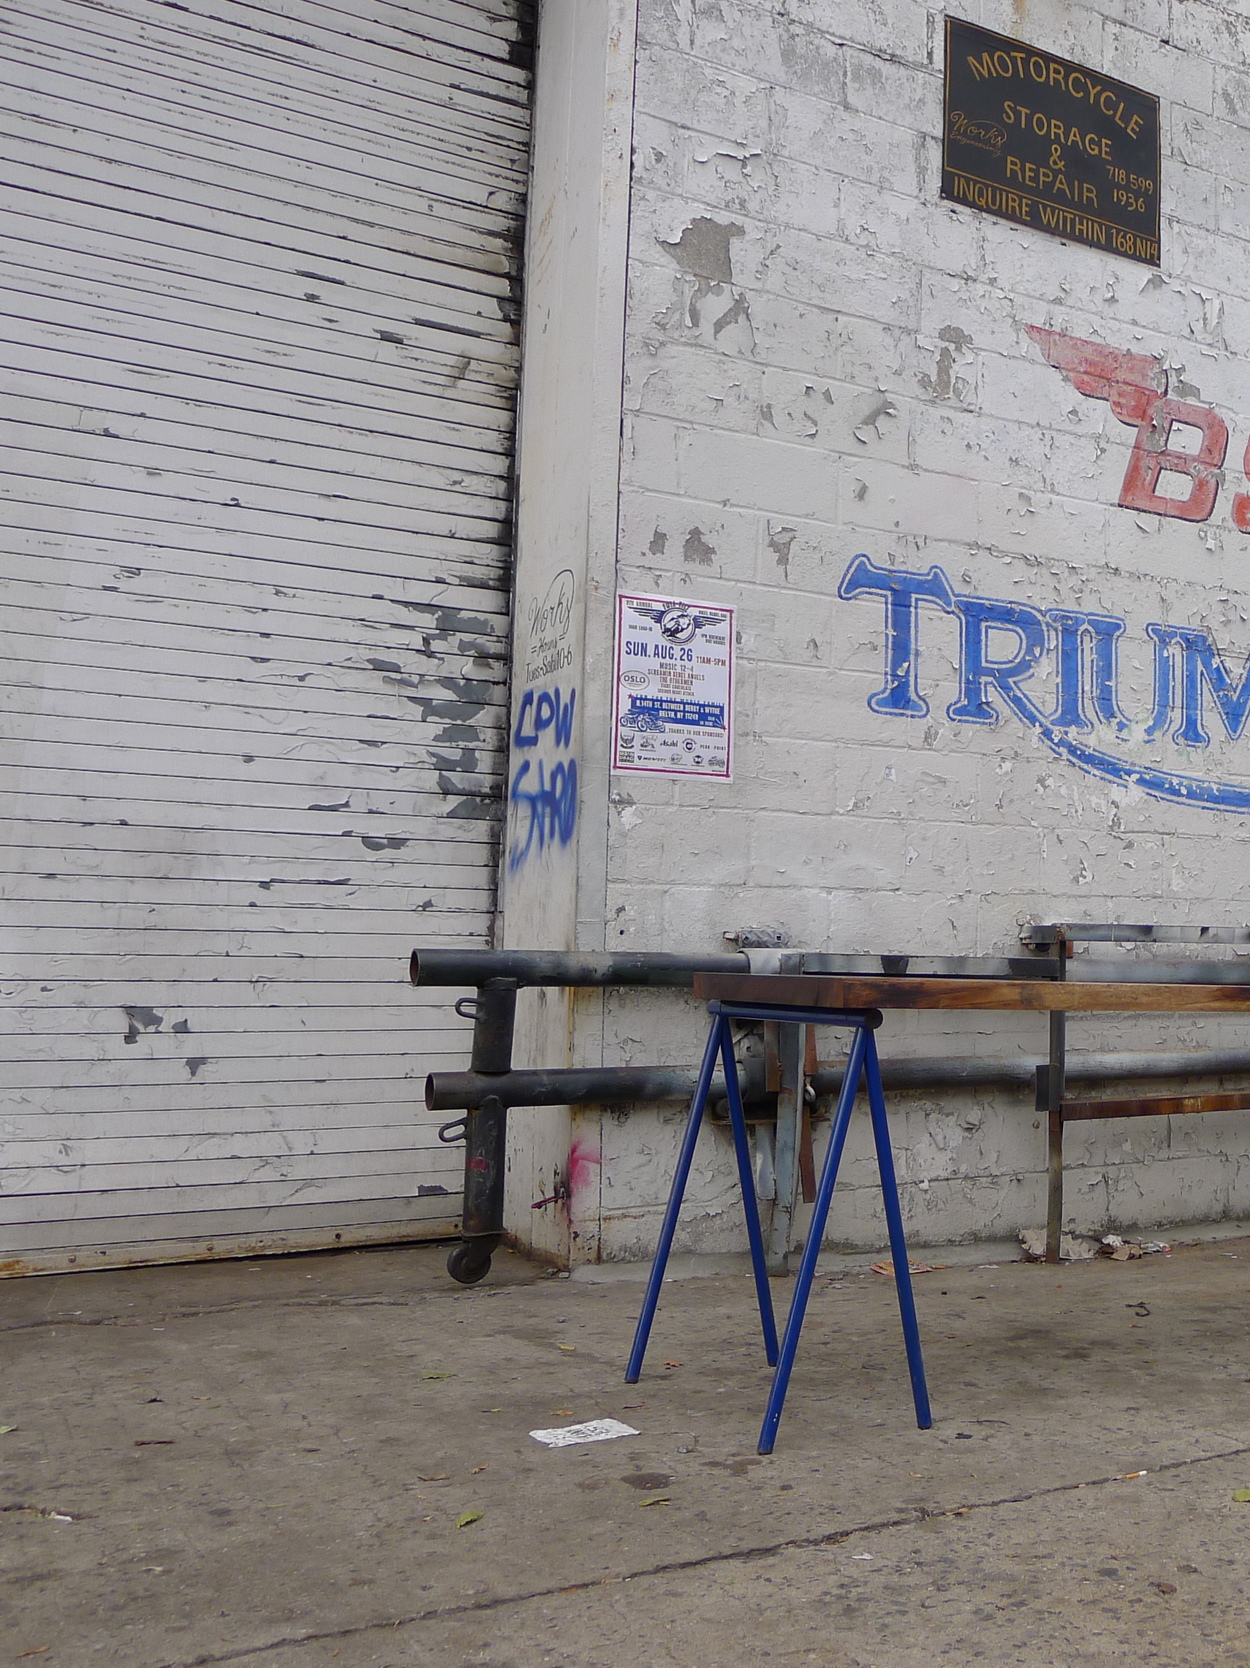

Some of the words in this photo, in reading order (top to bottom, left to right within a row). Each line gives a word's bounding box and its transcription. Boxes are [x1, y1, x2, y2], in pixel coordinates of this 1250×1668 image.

[967, 51, 1144, 139] MOTORCYCLE
[1002, 100, 1112, 161] STORAGE
[1049, 144, 1065, 171] &
[1006, 156, 1098, 208] REPAIR
[1106, 165, 1127, 185] 718
[1130, 174, 1154, 195] 599
[1113, 188, 1145, 213] 1936
[953, 176, 1031, 221] INQUIRE
[1039, 203, 1106, 245] WITHIN
[1110, 228, 1134, 255] 168
[625, 641, 651, 658] SUN.
[653, 643, 677, 661] AUG.
[680, 648, 693, 662] 26
[696, 656, 726, 667] 11AM-5PM
[624, 675, 646, 684] OSLO
[659, 662, 678, 671] MUSIC
